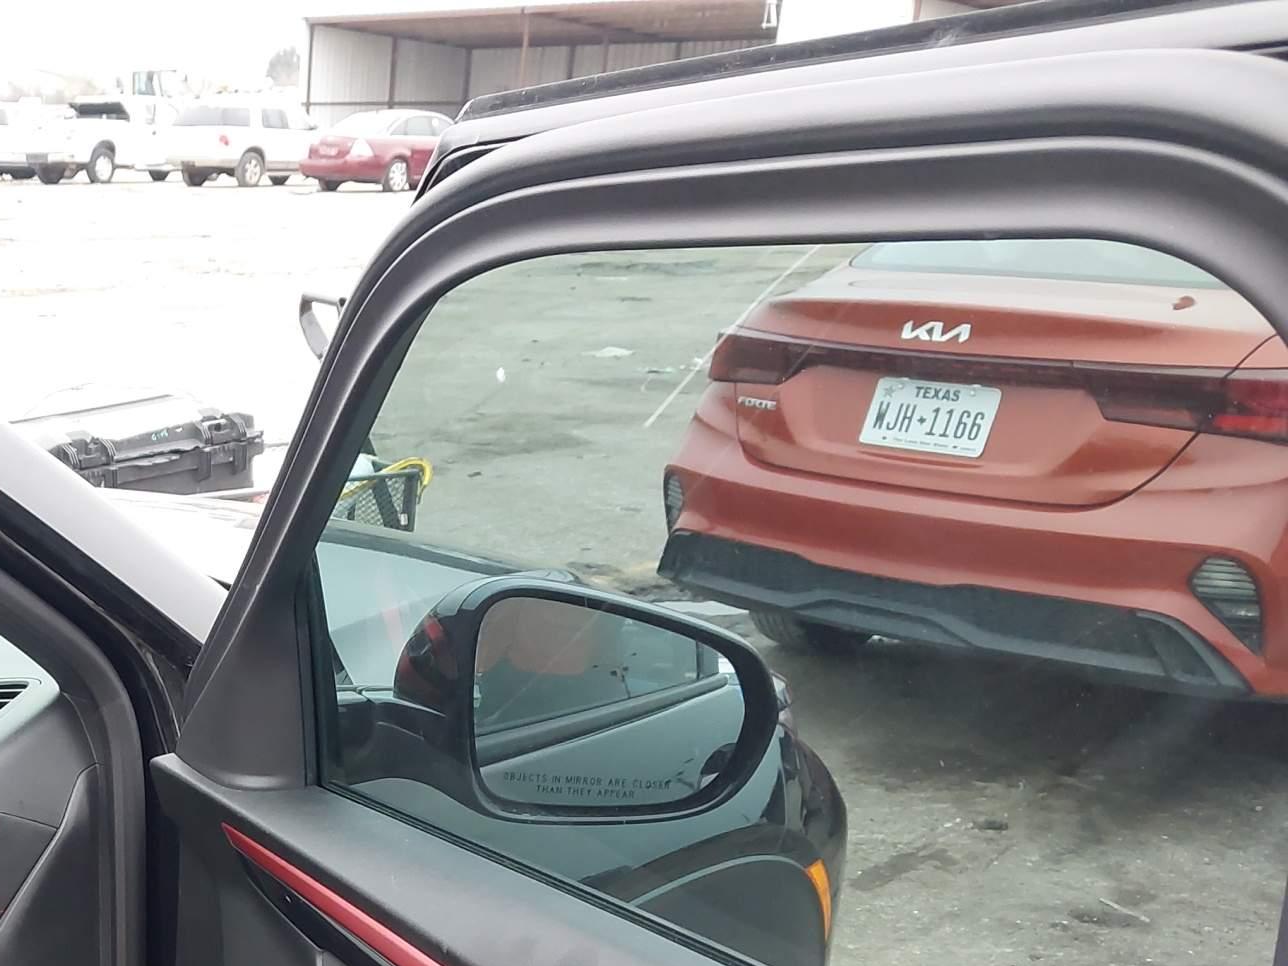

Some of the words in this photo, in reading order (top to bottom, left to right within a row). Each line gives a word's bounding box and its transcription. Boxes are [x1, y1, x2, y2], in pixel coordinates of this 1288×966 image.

[915, 386, 960, 402] TEXAS
[503, 772, 548, 783] OBJECTS
[551, 775, 561, 784] IN
[565, 776, 603, 787] MIRROR
[608, 778, 626, 788] ARE
[632, 779, 672, 790] CLOSER
[536, 784, 562, 795] THAN
[567, 786, 592, 797] THEY
[597, 788, 635, 799] APPEAR
